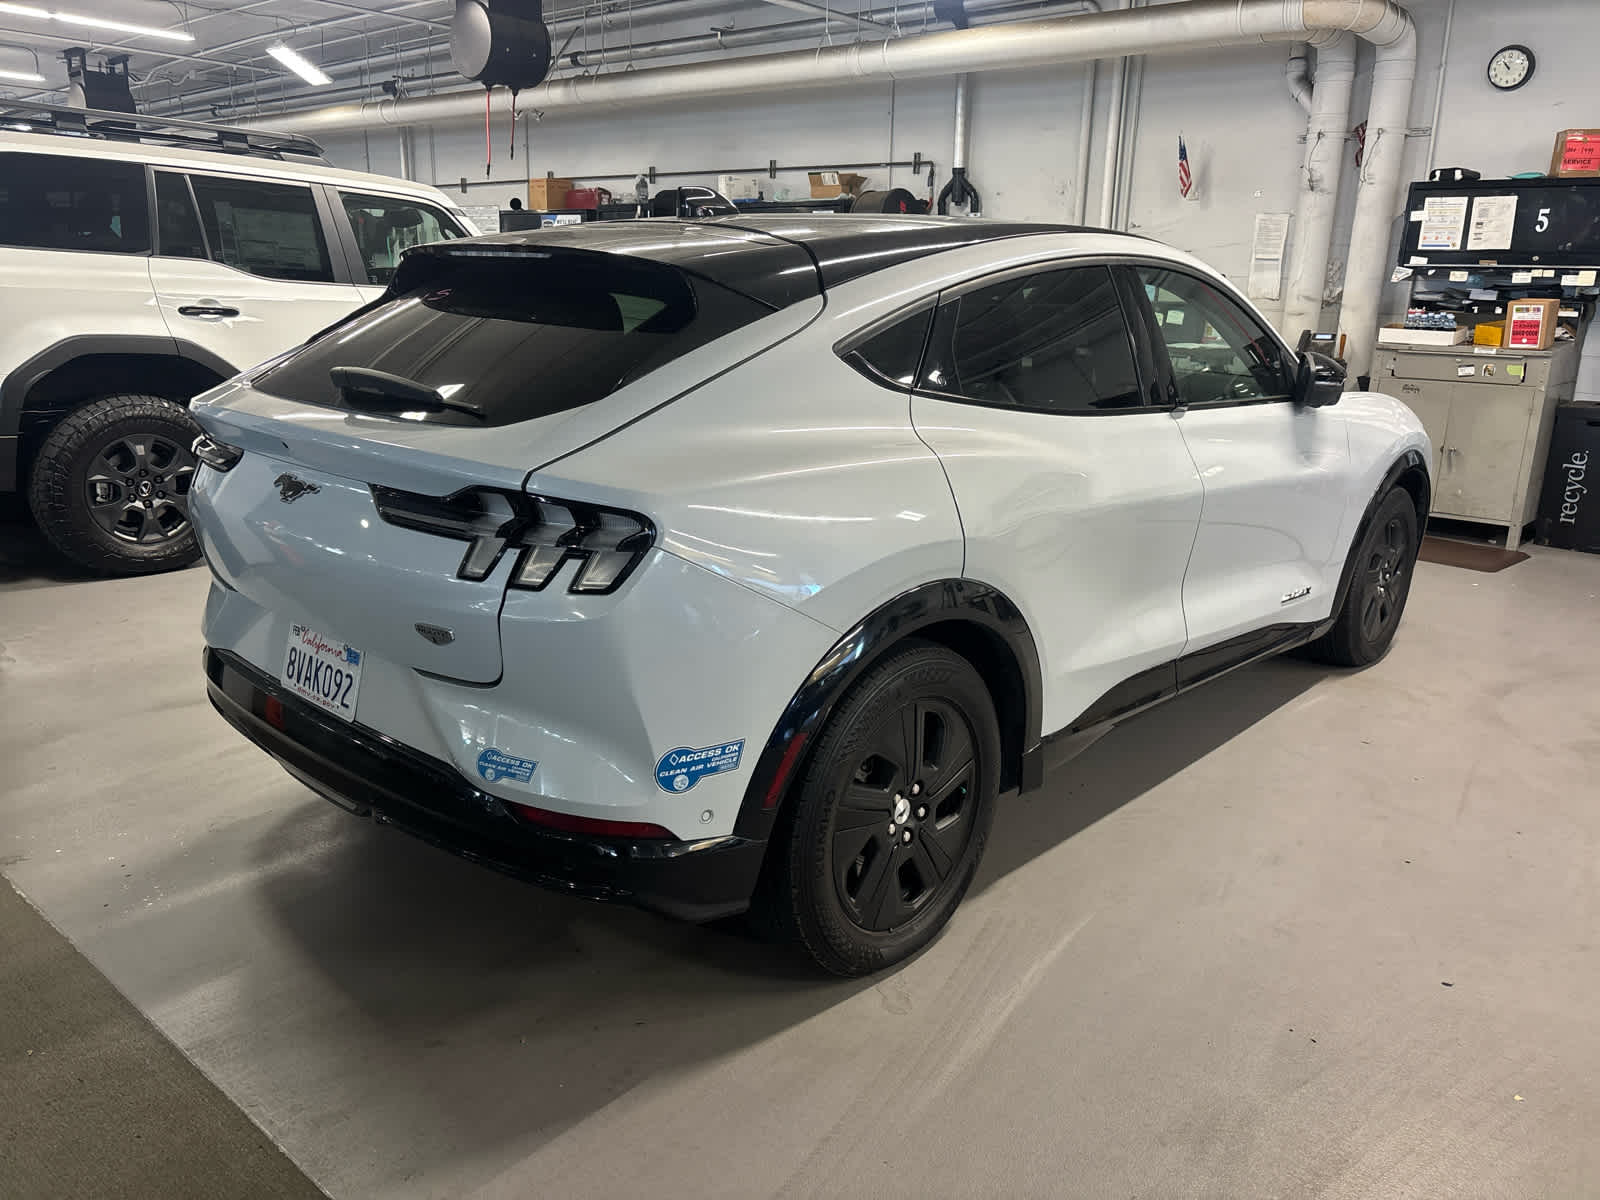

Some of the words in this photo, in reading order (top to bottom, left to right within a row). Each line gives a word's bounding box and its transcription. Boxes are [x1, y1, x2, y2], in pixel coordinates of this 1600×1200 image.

[1535, 208, 1551, 233] 5
[1560, 450, 1590, 525] recycle.
[302, 629, 345, 661] California
[286, 646, 353, 709] 8VAK092
[491, 755, 520, 766] ACCESS
[678, 748, 722, 764] ACCESS
[725, 743, 740, 754] OK
[659, 767, 688, 777] CLEAN
[690, 764, 705, 772] AIR
[706, 756, 738, 768] VEHICLE
